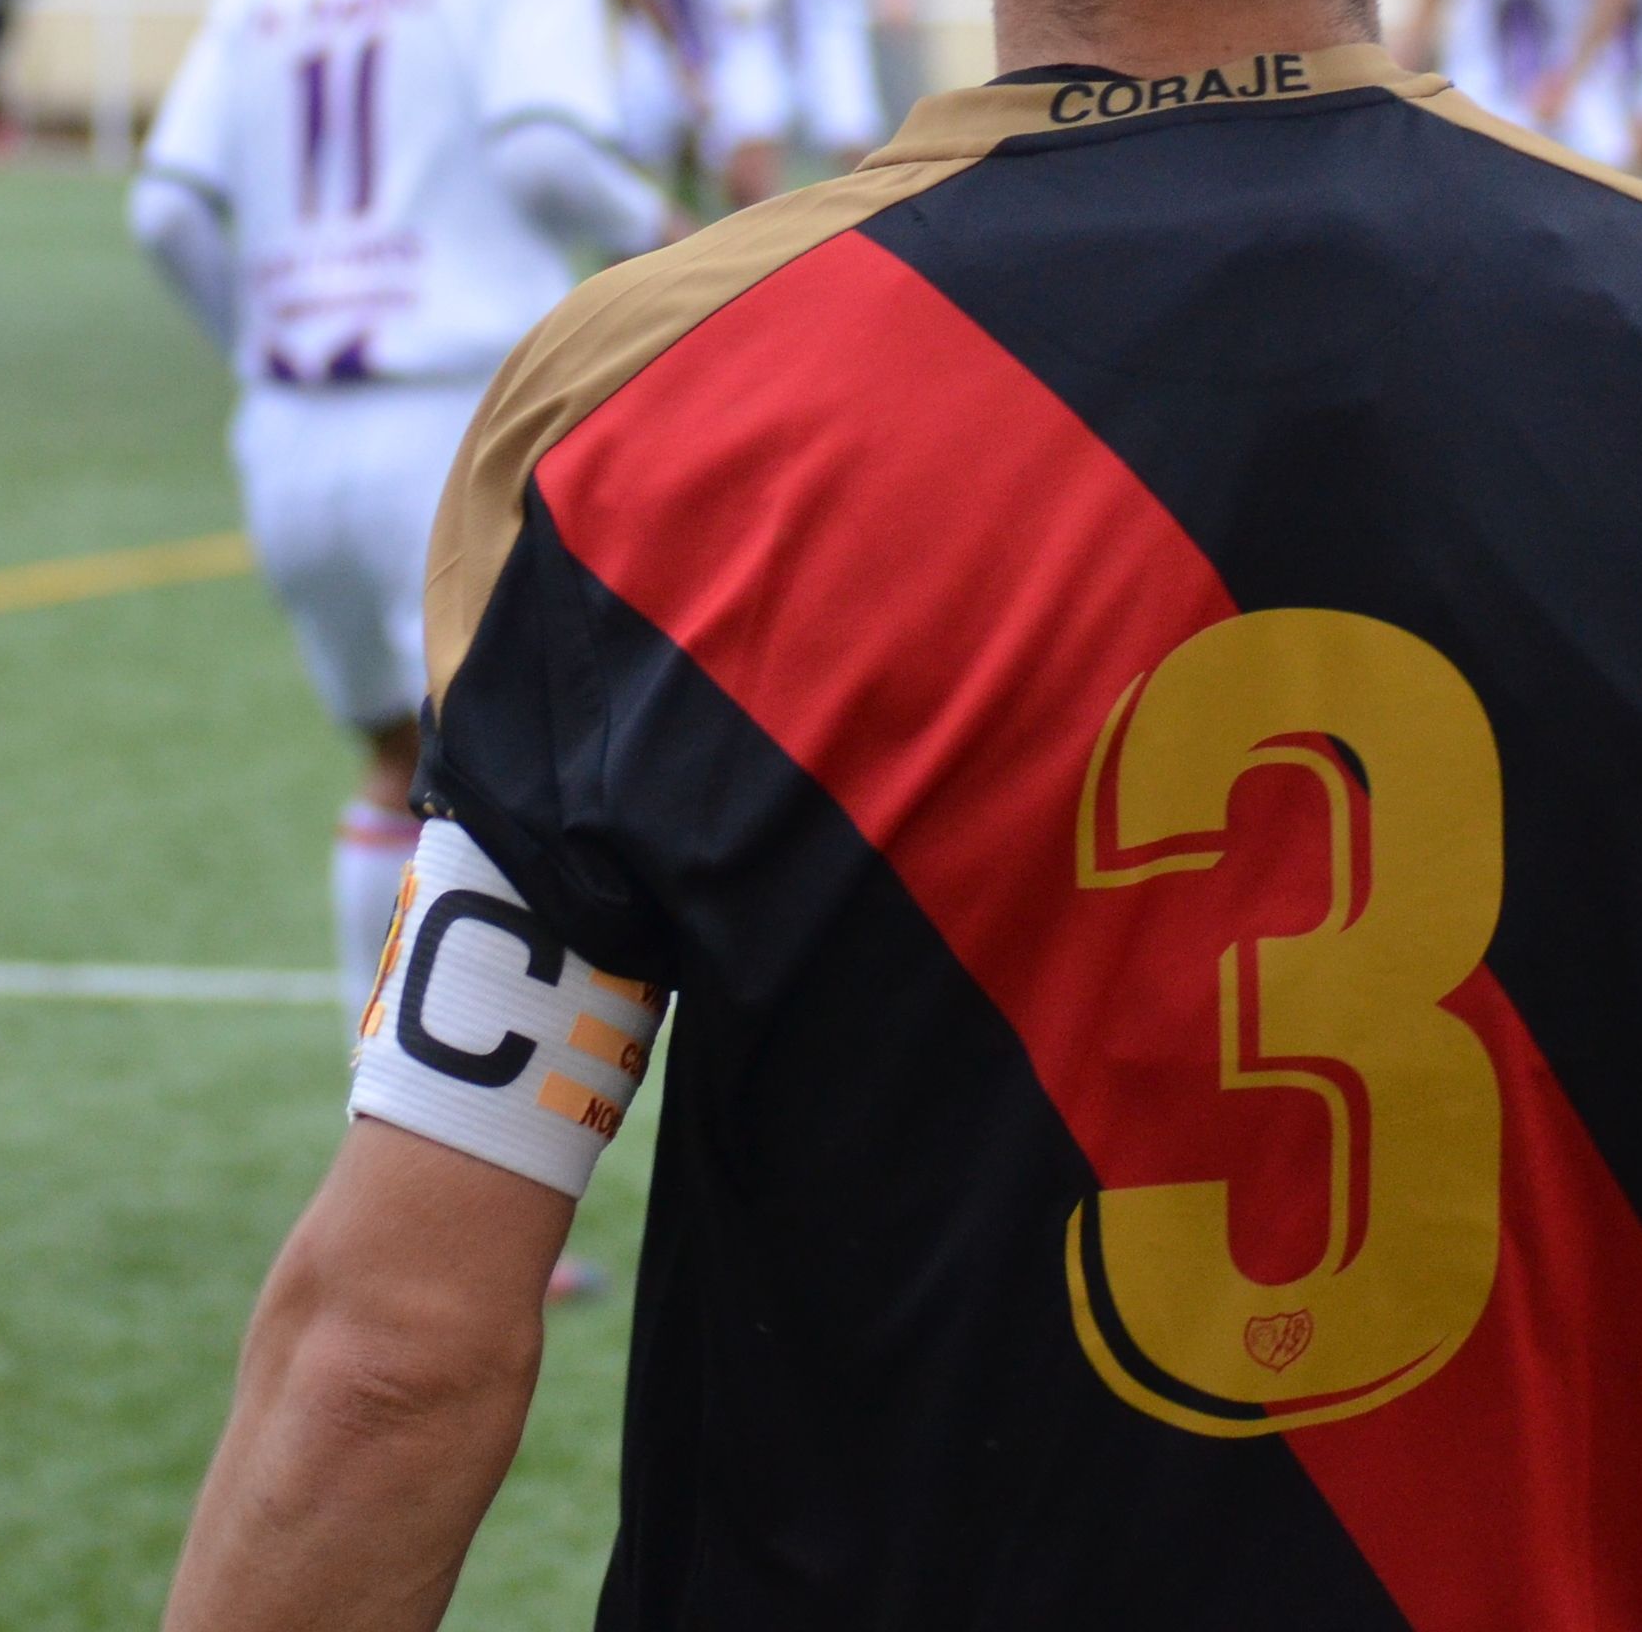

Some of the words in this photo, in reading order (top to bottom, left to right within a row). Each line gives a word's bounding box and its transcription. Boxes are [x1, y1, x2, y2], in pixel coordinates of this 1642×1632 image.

[298, 38, 381, 220] 11
[1050, 54, 1309, 123] CORAJE
[398, 889, 565, 1087] C
[1065, 607, 1504, 1438] 3
